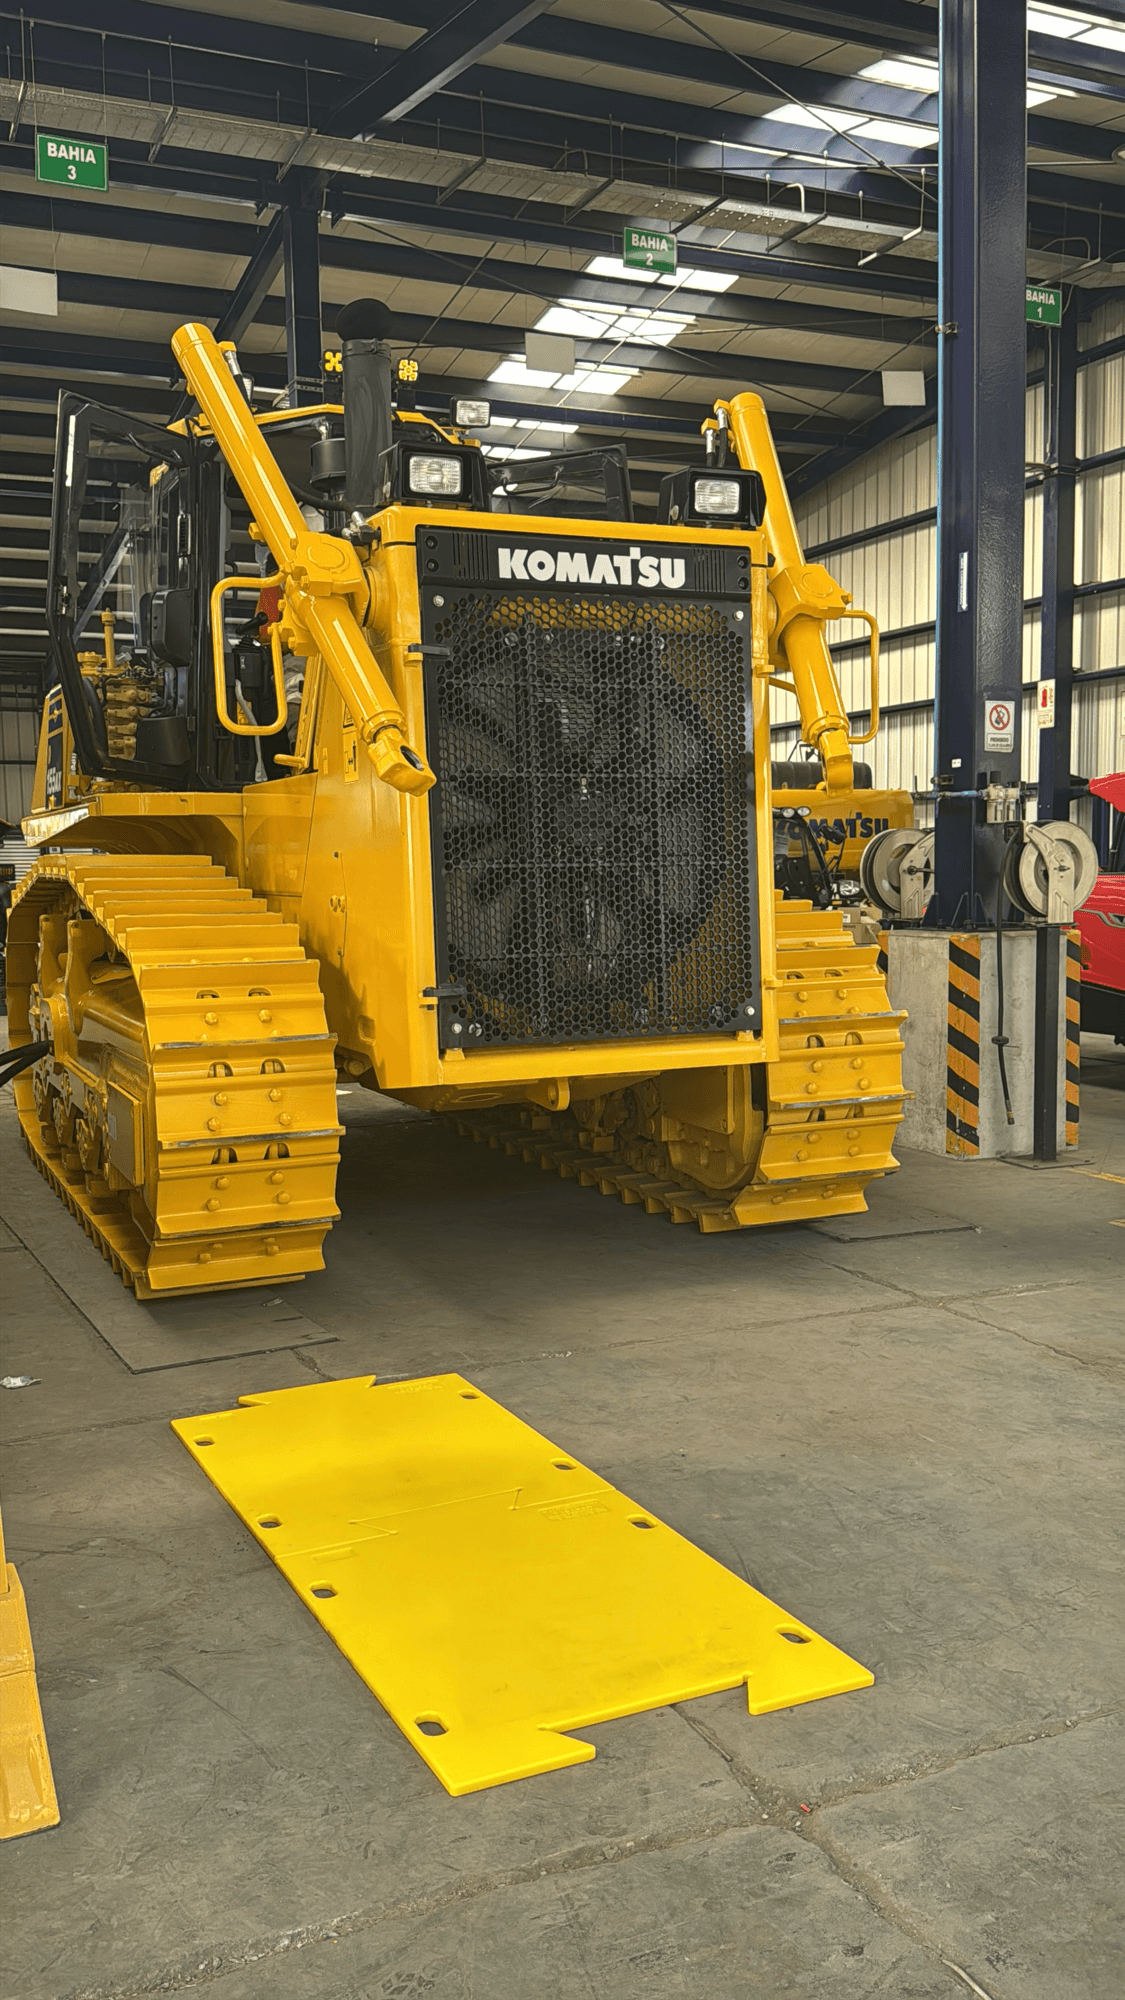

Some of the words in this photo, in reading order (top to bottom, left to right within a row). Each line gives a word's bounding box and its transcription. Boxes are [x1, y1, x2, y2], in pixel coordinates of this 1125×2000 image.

[47, 142, 97, 165] BAHIA
[67, 165, 77, 180] 3
[631, 233, 669, 252] BAHIA
[646, 253, 653, 266] 2
[1026, 290, 1055, 305] BAHIA
[1037, 307, 1042, 318] 1
[498, 547, 686, 589] KOMATSU
